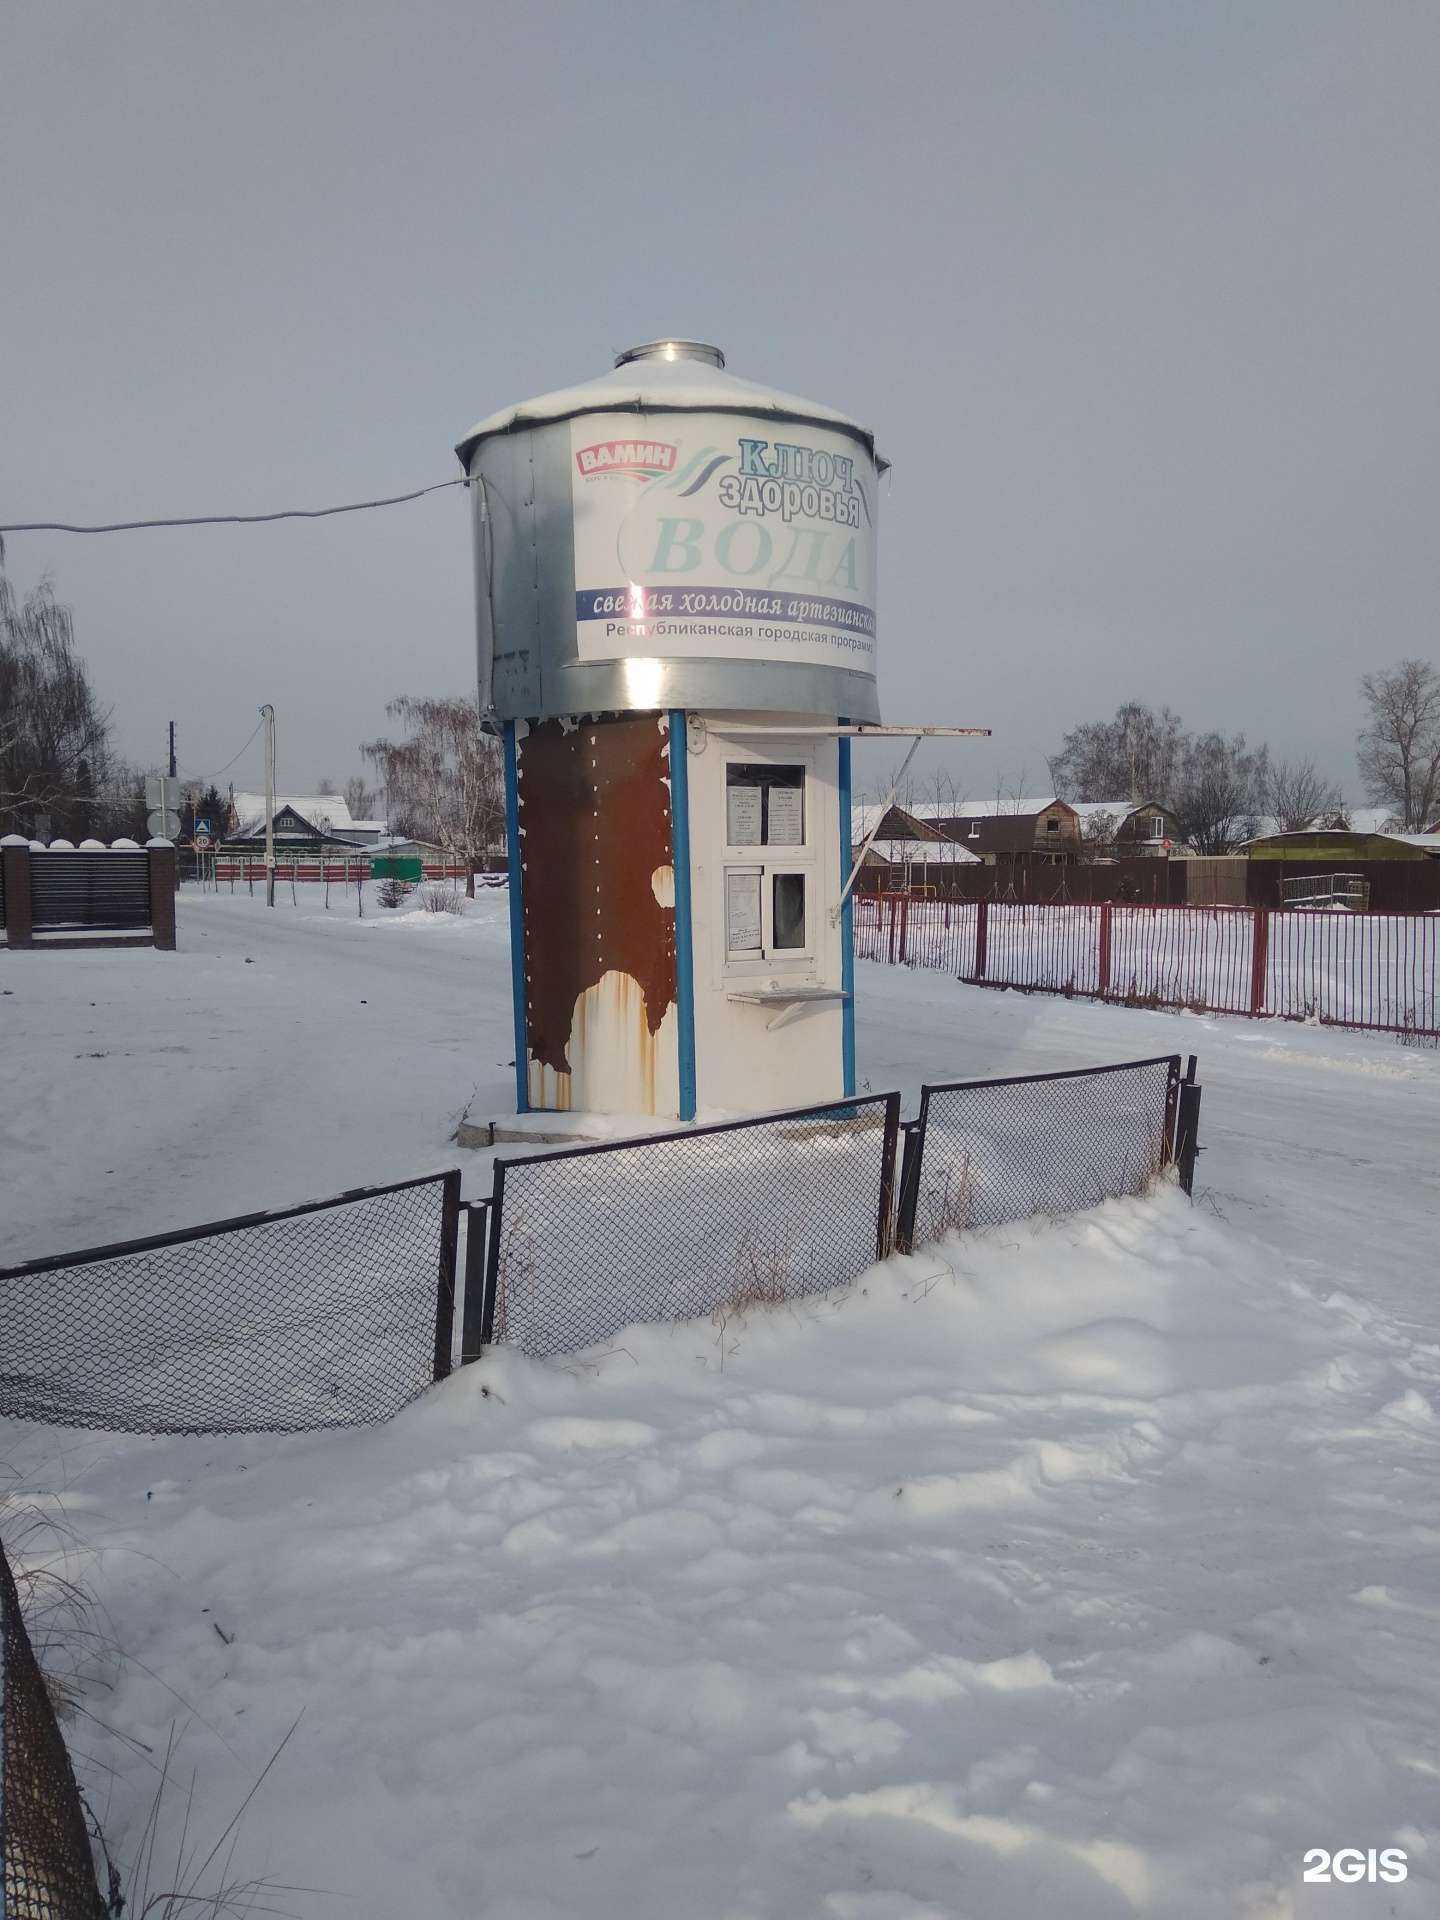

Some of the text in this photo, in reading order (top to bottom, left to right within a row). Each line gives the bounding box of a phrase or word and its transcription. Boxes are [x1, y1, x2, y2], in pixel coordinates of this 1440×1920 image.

[580, 443, 673, 471] ВАМИН
[641, 516, 859, 592] ВОДА
[680, 590, 784, 615] холодная
[606, 620, 753, 638] Республиканская
[759, 627, 828, 643] городская
